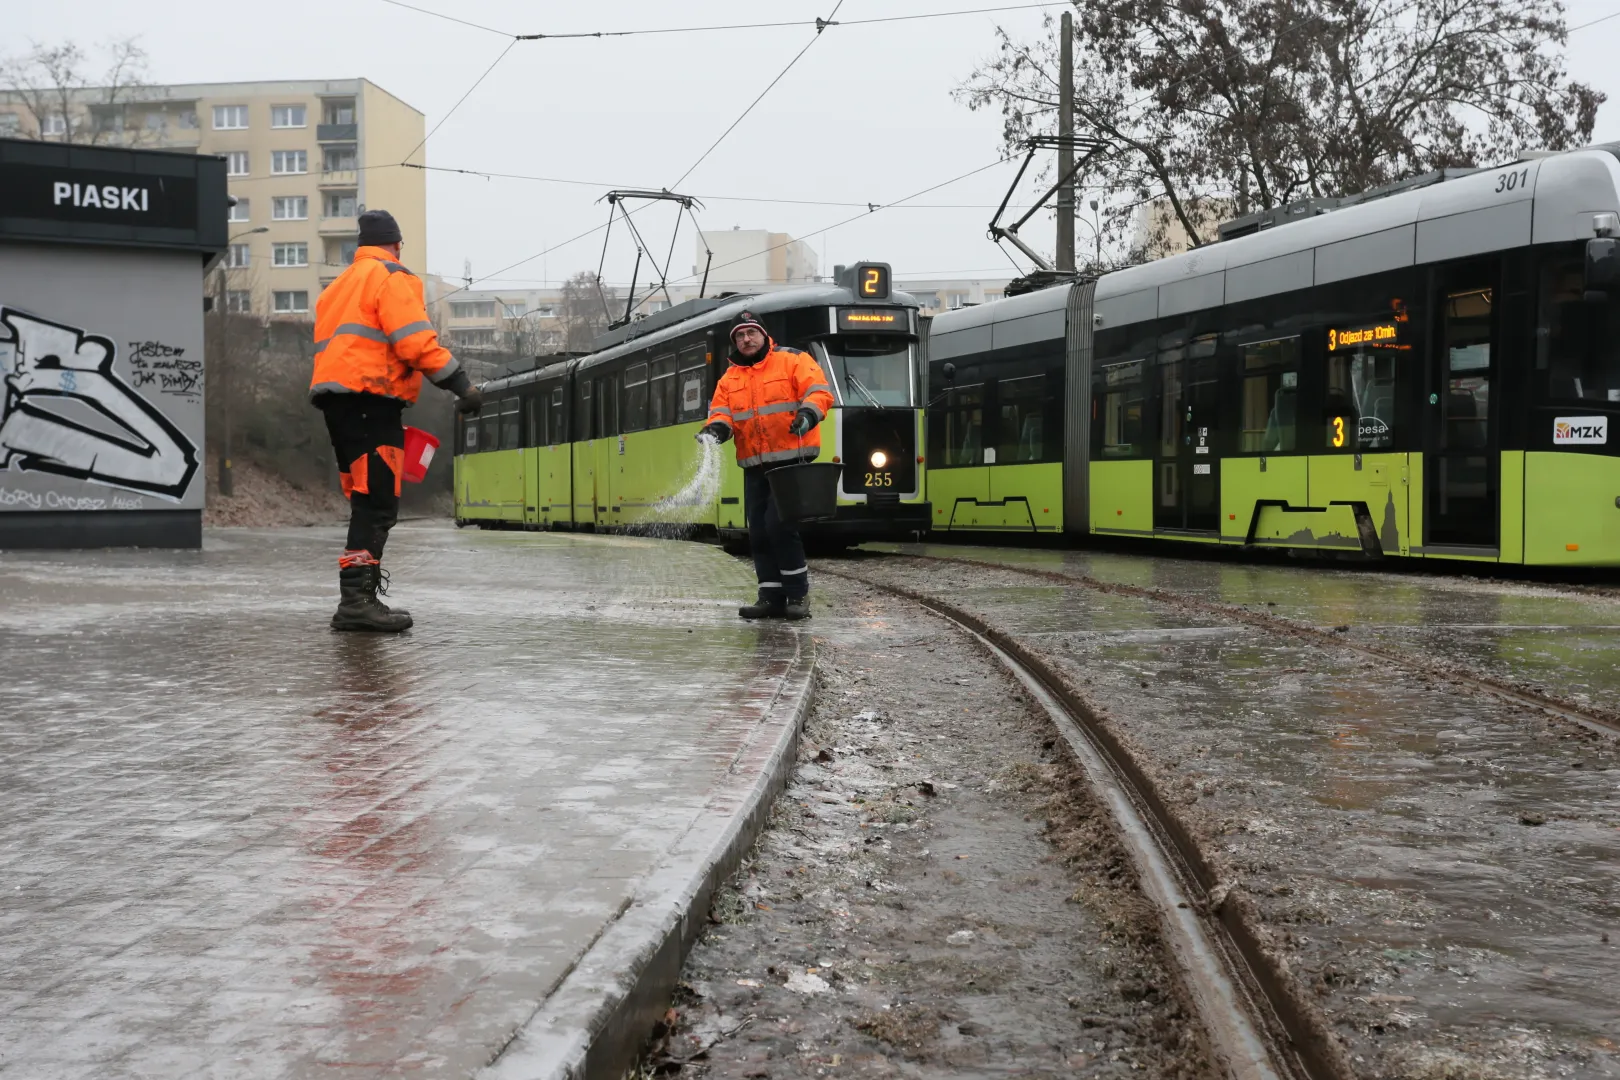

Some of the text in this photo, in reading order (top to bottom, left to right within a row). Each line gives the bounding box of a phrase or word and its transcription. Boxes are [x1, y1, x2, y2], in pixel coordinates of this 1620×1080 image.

[1495, 168, 1528, 193] 301
[53, 182, 149, 211] PIASKI
[864, 270, 879, 293] 2
[1328, 329, 1337, 351] 3
[1332, 416, 1344, 448] 3
[1358, 425, 1385, 437] pesa
[1570, 426, 1603, 438] MZK
[865, 472, 892, 487] 255
